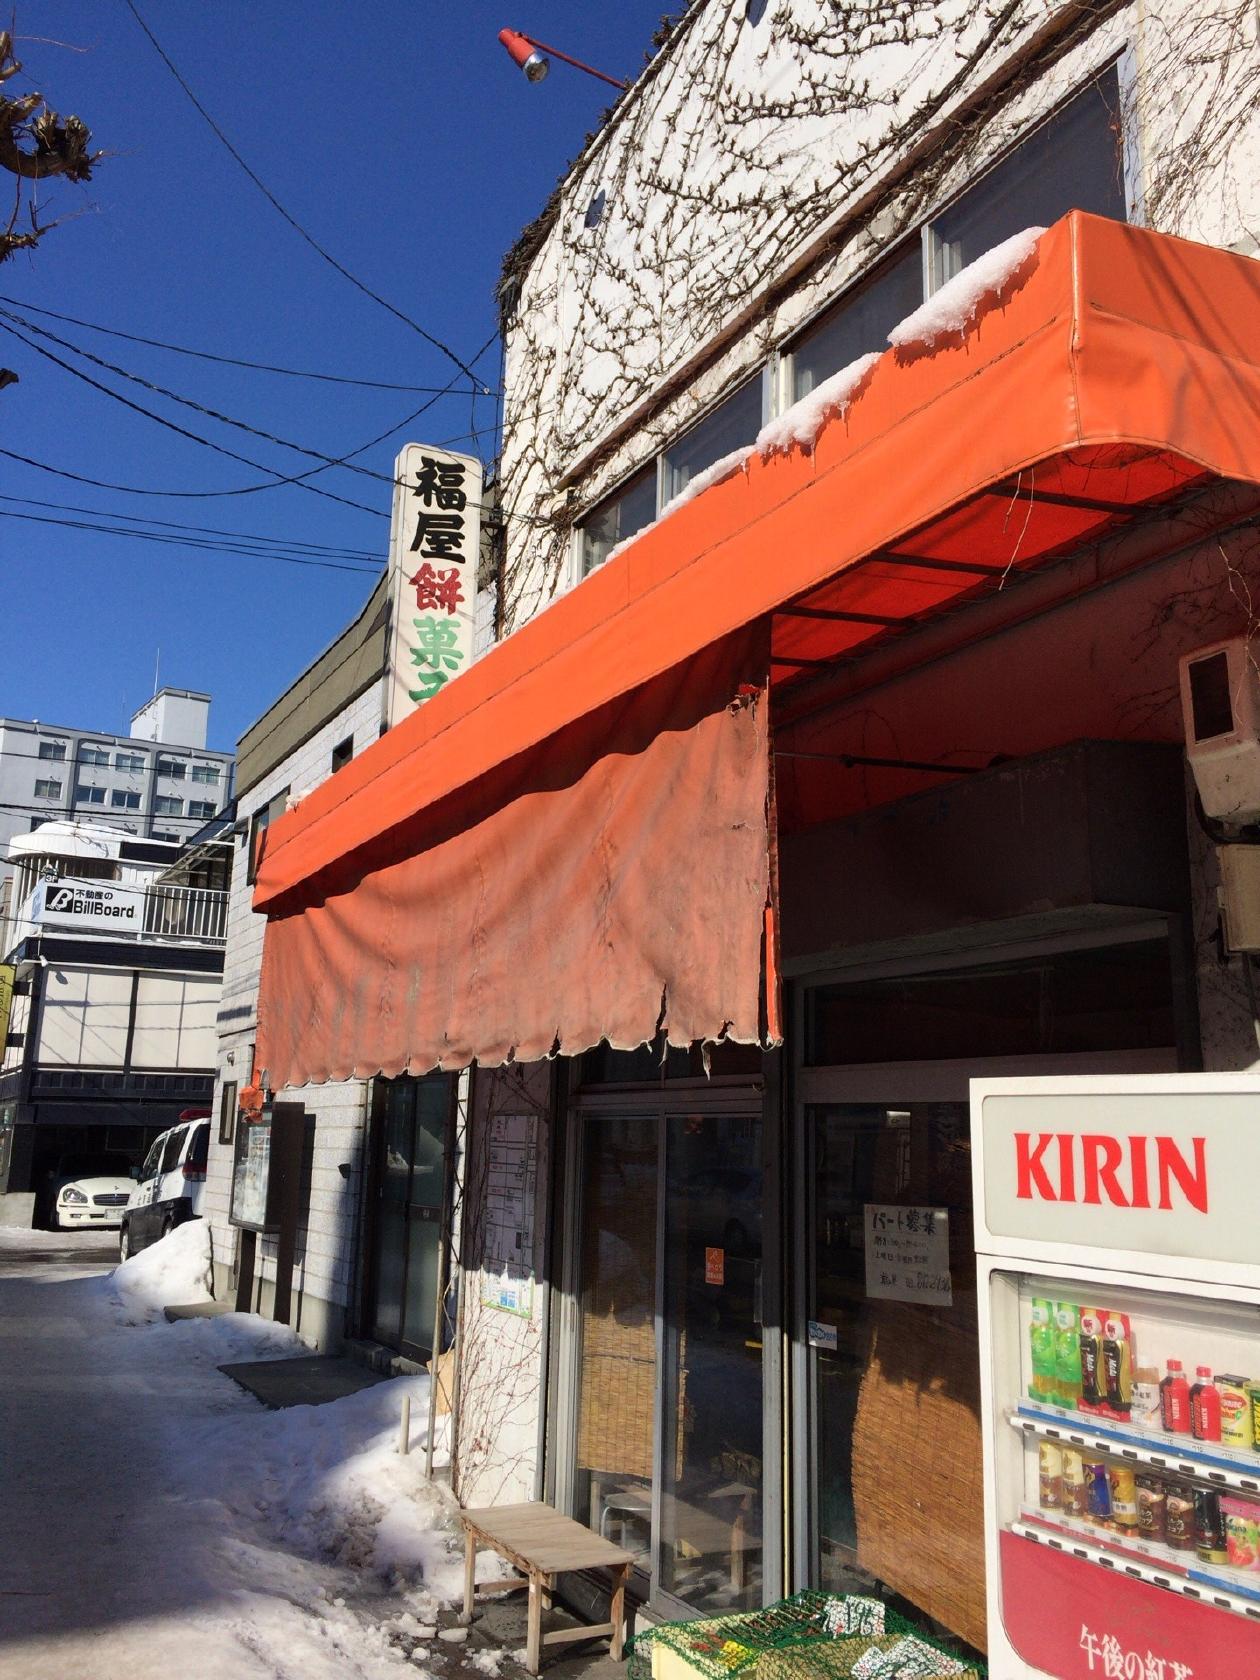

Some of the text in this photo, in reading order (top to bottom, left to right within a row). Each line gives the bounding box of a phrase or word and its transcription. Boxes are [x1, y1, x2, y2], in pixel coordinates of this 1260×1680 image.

[75, 888, 114, 900] 不動産の
[73, 900, 135, 918] BillBoard
[1013, 1132, 1209, 1215] KIRIN
[1171, 1398, 1180, 1420] KIRIN
[1201, 1407, 1209, 1429] KIRIN
